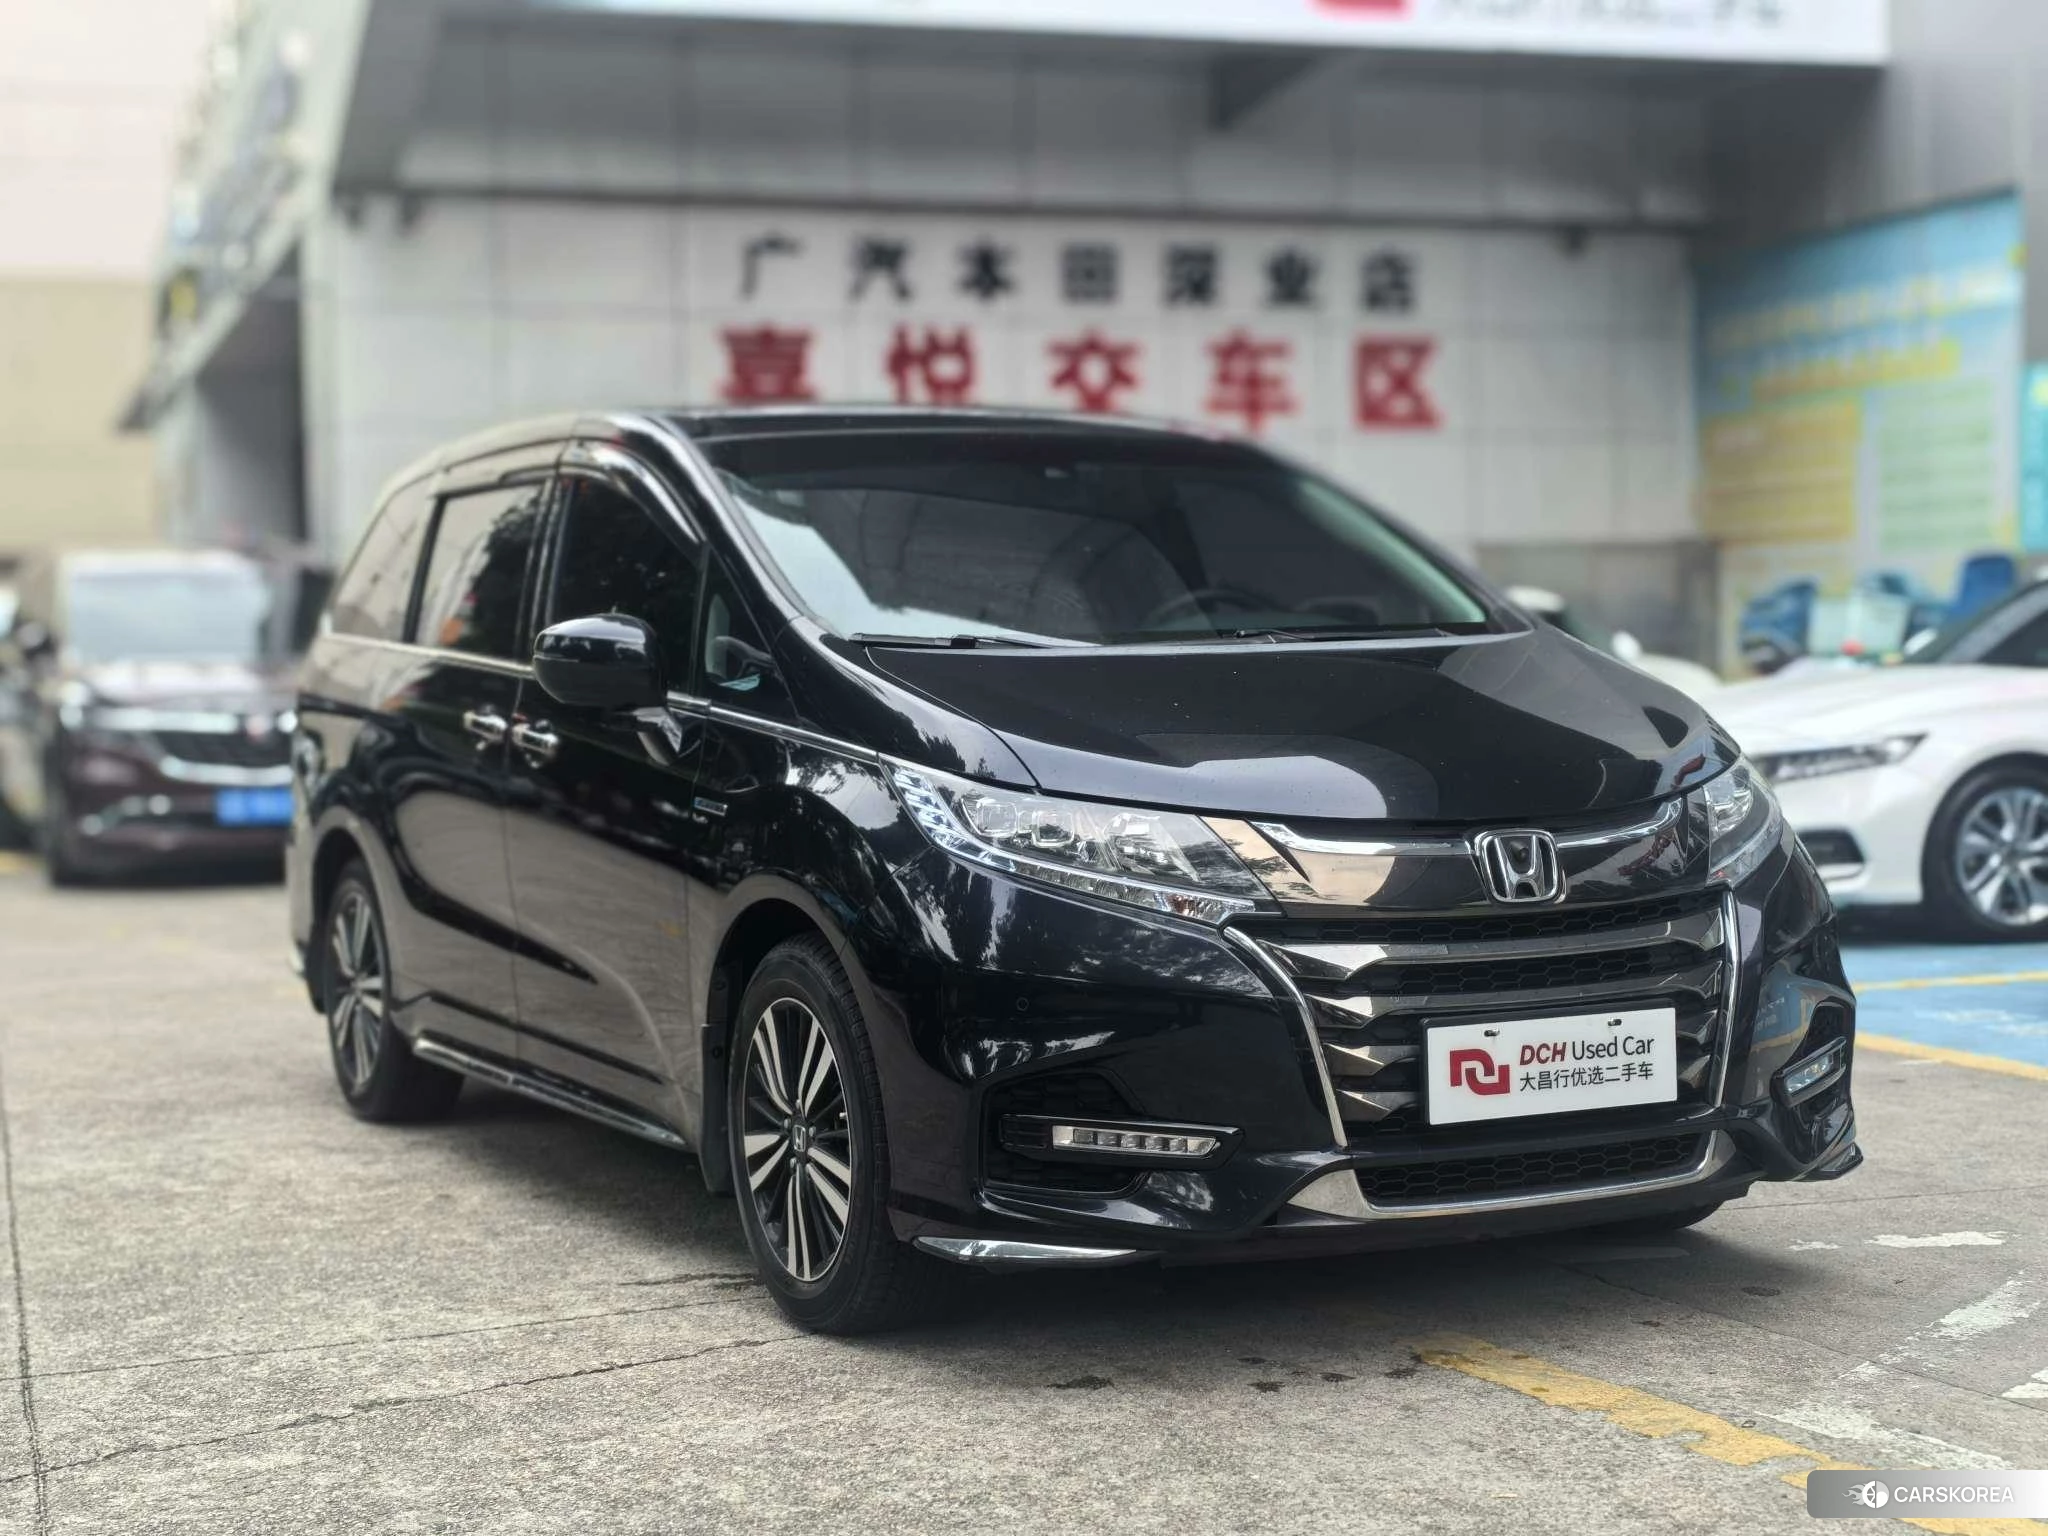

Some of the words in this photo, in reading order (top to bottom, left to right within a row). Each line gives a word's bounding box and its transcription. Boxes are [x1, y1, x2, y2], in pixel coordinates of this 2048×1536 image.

[741, 231, 1416, 312] 广汽本田深业店
[719, 324, 1441, 432] 喜悦交车区
[1519, 1041, 1567, 1066] DCH
[1572, 1036, 1618, 1061] Used
[1622, 1035, 1655, 1056] Car
[1519, 1061, 1654, 1092] 大昌行优选二手车
